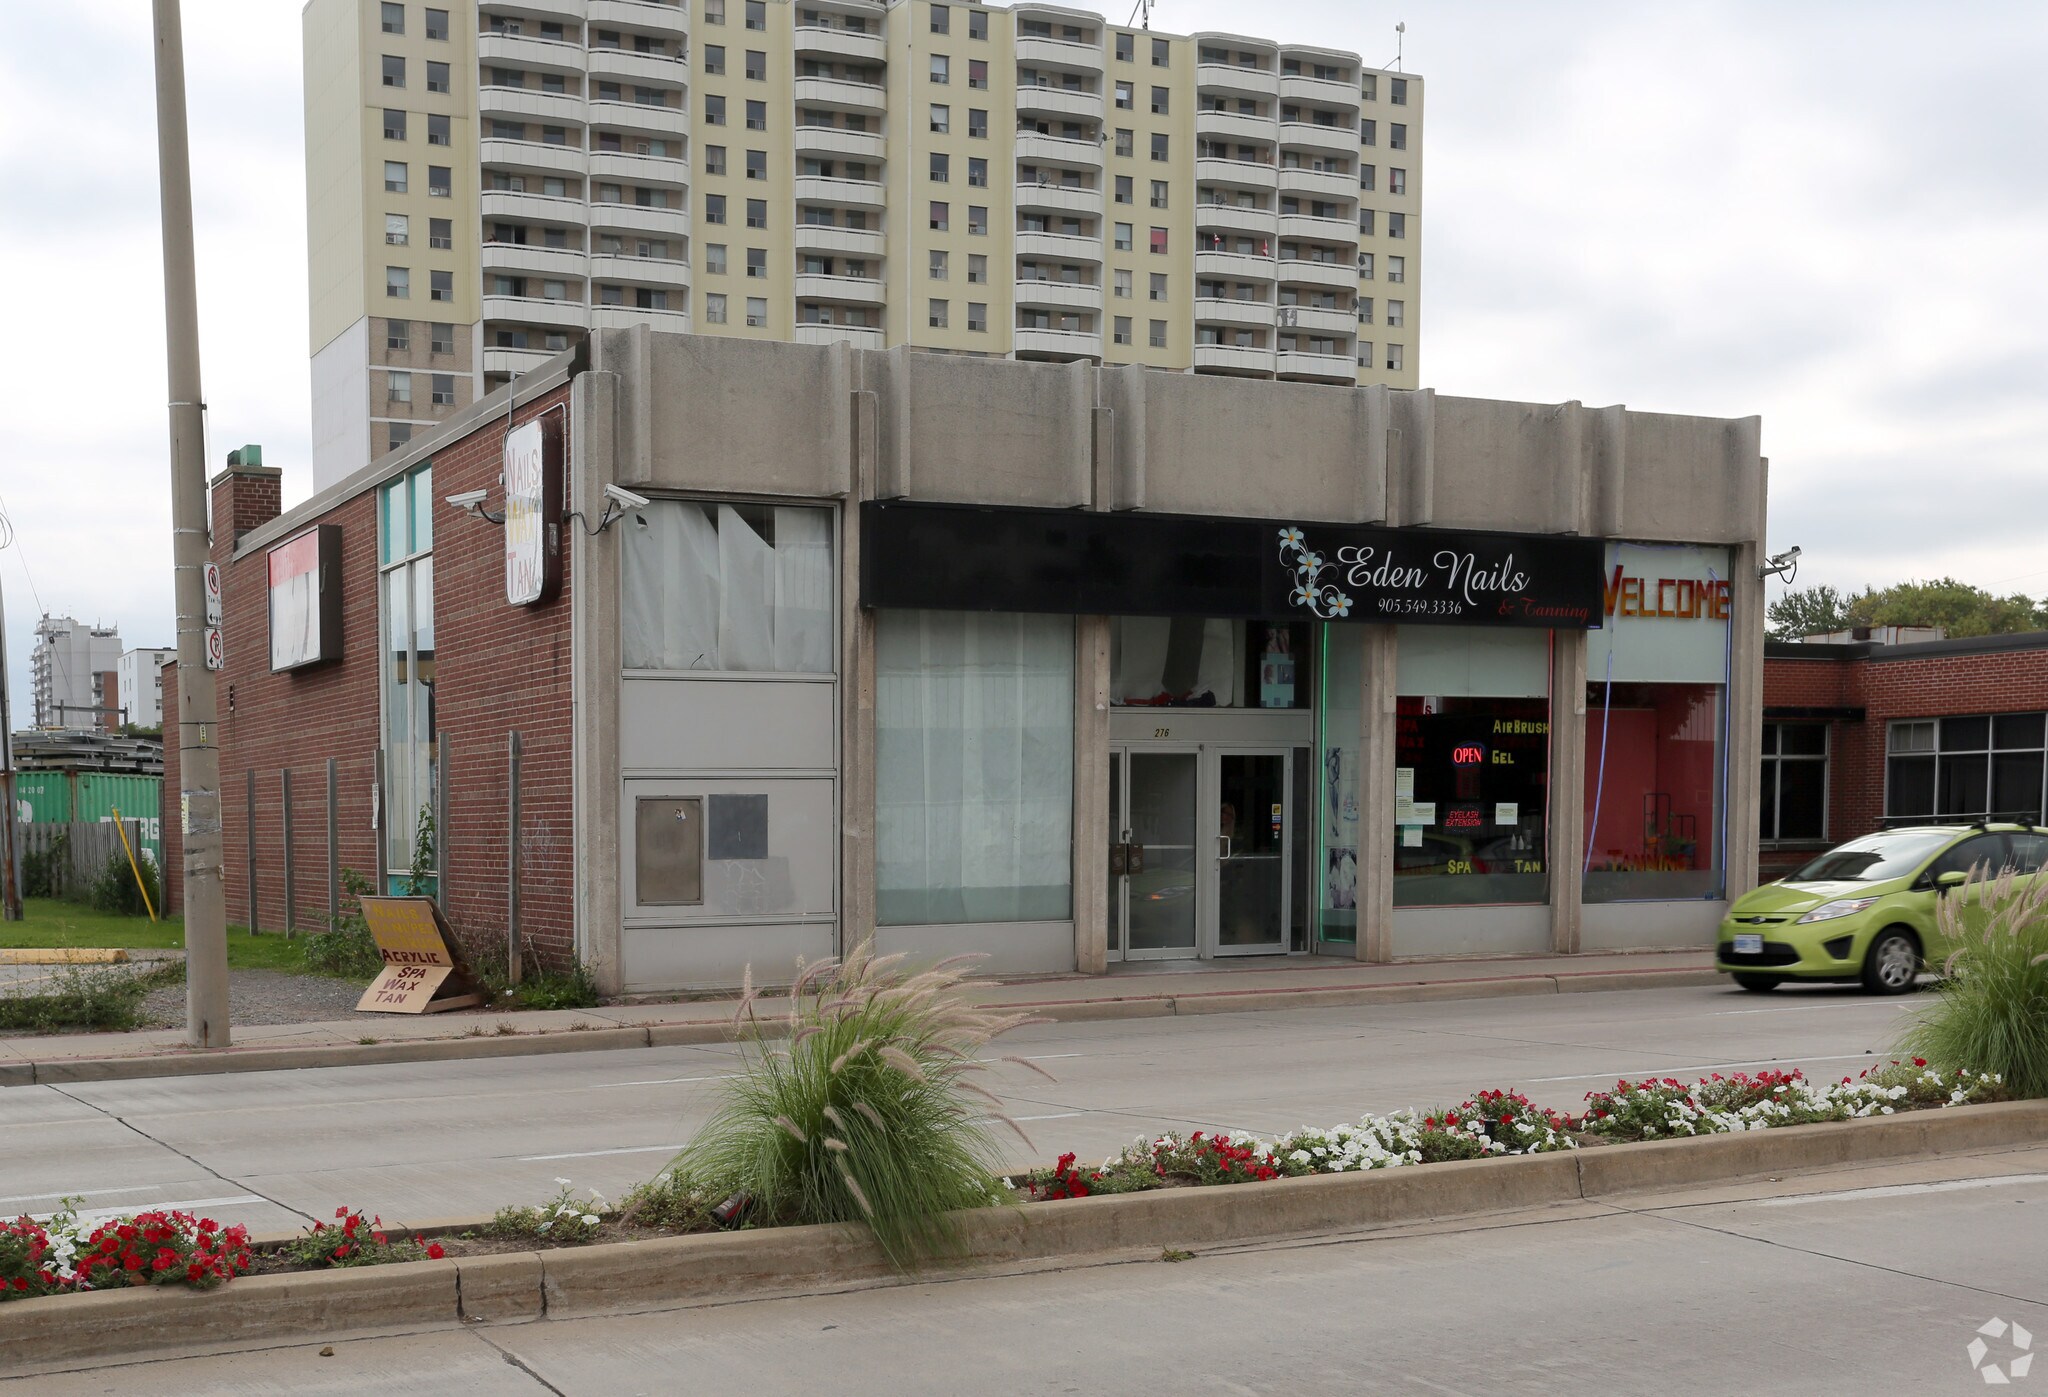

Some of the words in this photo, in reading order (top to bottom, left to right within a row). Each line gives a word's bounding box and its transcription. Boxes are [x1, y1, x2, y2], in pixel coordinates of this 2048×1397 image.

[507, 448, 539, 496] NAILS
[507, 500, 535, 545] WAX
[508, 551, 532, 598] TAN
[1337, 546, 1428, 588] Eden
[1433, 551, 1530, 606] Nails
[1378, 598, 1462, 616] 905.549.3336
[1520, 597, 1590, 624] Tanning
[1154, 728, 1170, 738] 276
[1454, 748, 1482, 763] OPEN
[1492, 750, 1514, 764] GEL
[1450, 810, 1479, 819] EYELASH
[1445, 818, 1482, 827] EXTENSION
[1448, 860, 1472, 874] SPA
[1515, 860, 1540, 873] TAN
[372, 903, 420, 920] NAILS
[381, 949, 440, 963] ACRYLIC
[397, 967, 427, 978] SPA
[383, 979, 420, 991] WAX
[375, 991, 407, 1003] TAN
